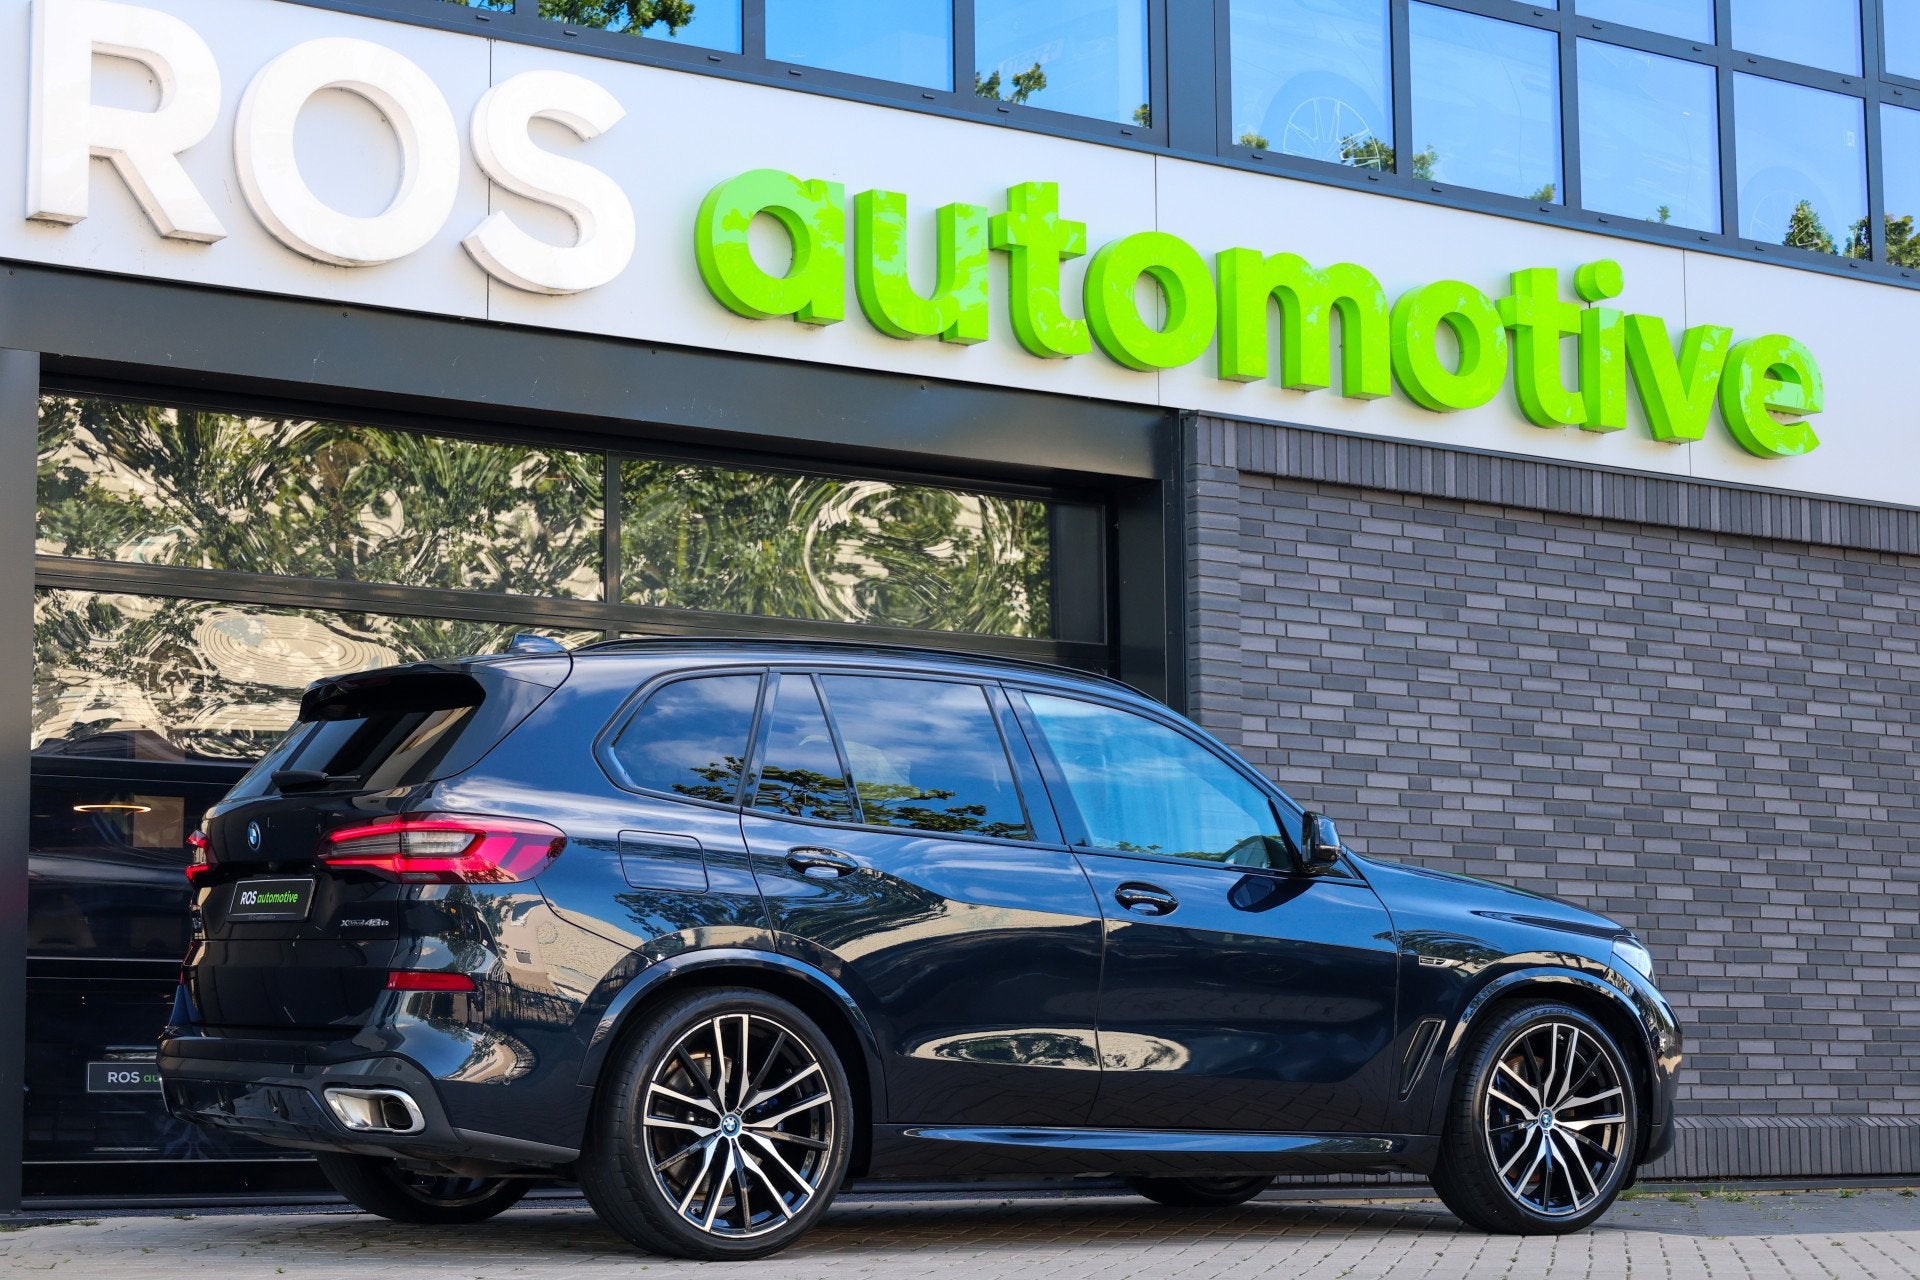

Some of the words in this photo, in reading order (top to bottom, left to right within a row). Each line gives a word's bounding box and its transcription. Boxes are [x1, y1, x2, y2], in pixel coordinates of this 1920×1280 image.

[26, 0, 636, 296] ROS
[694, 168, 1824, 460] automotive
[240, 890, 258, 905] ROS
[257, 890, 299, 904] automotive
[107, 1071, 140, 1083] ROS
